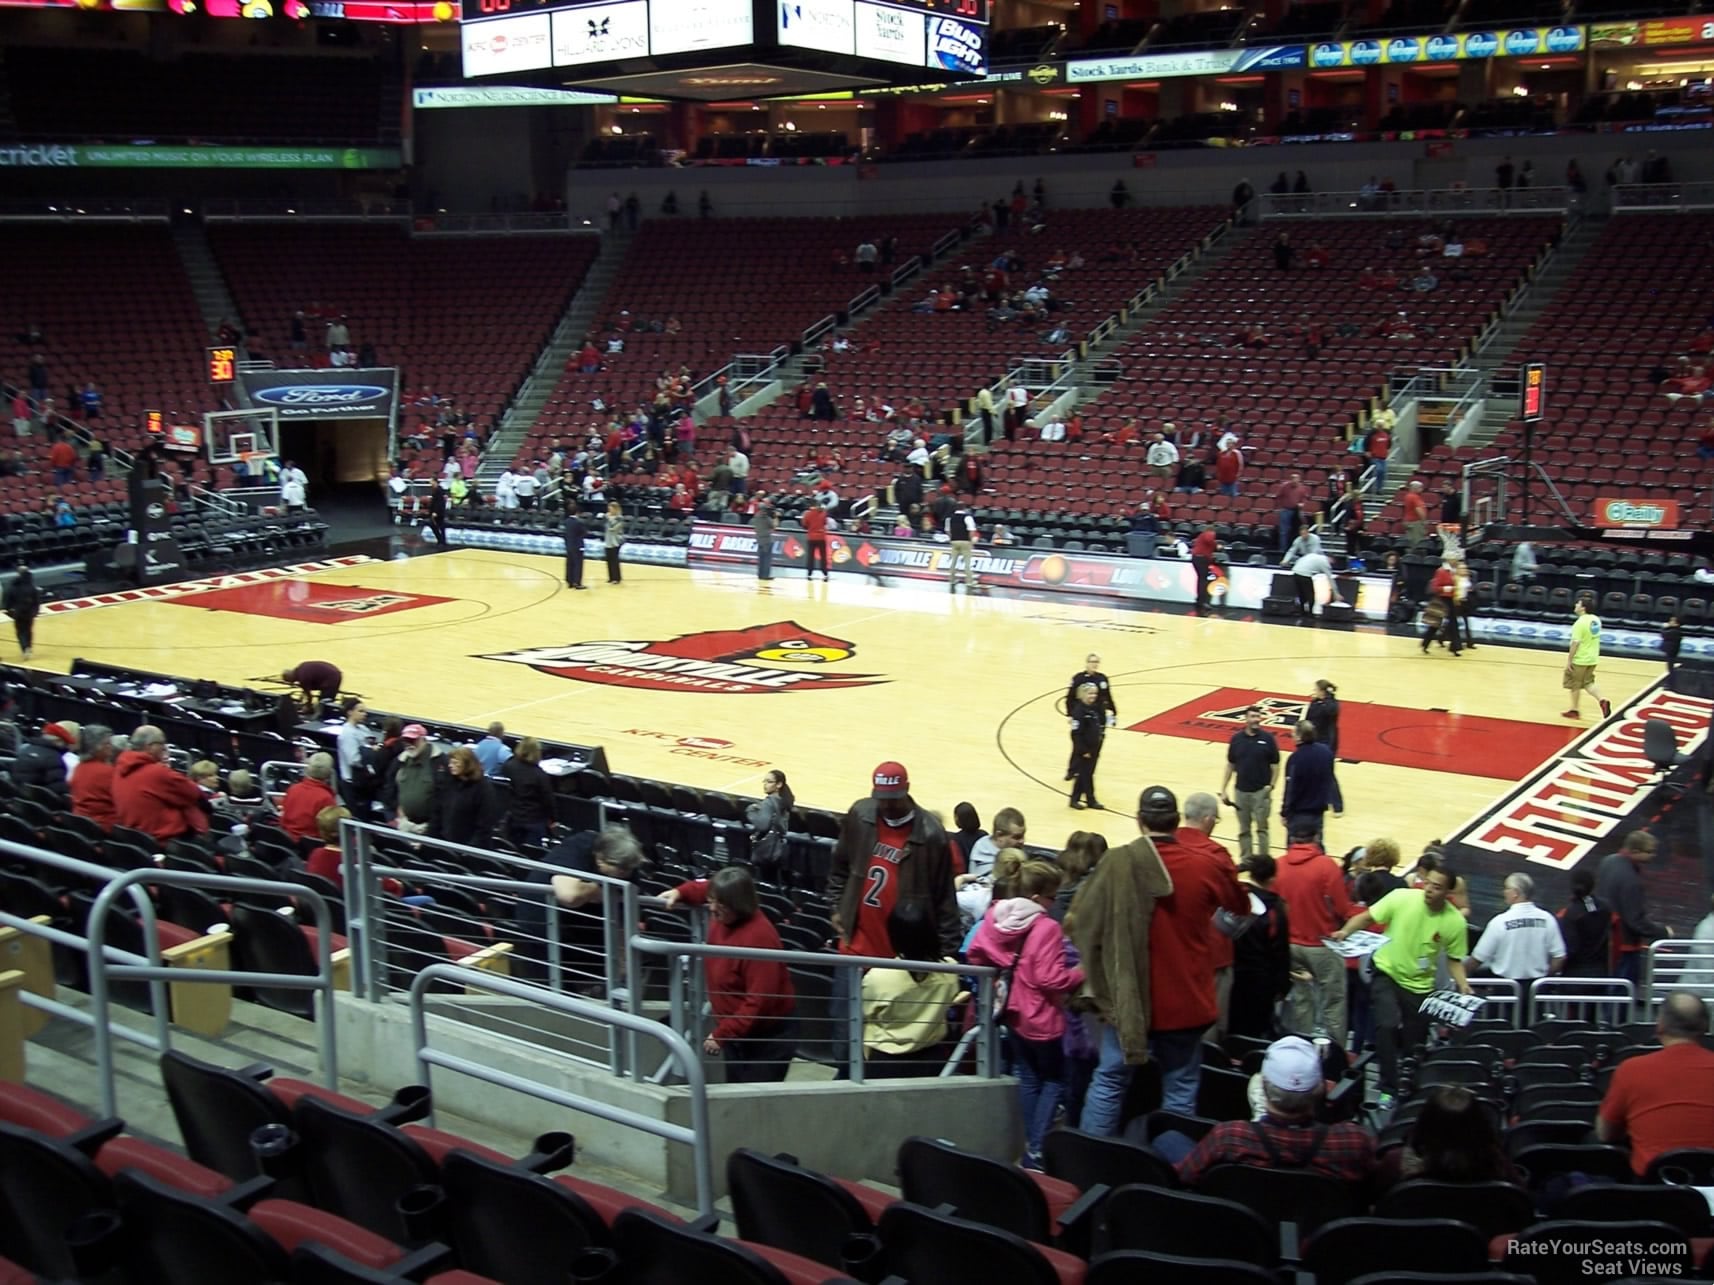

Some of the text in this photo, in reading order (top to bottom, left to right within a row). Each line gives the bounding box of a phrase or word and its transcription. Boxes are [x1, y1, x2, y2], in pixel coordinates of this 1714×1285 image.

[937, 18, 982, 50] BUD
[934, 34, 983, 67] LIGHT
[1070, 65, 1106, 78] Stock
[1109, 62, 1144, 76] Yards
[0, 145, 79, 166] cricket
[303, 151, 334, 162] PLAN
[281, 388, 367, 403] Ford
[310, 404, 376, 414] Further
[478, 640, 826, 688] LOUISVILLE
[585, 664, 751, 691] CARDINALS
[619, 728, 681, 741] KFC
[669, 748, 773, 767] CENTER
[863, 865, 889, 908] 2
